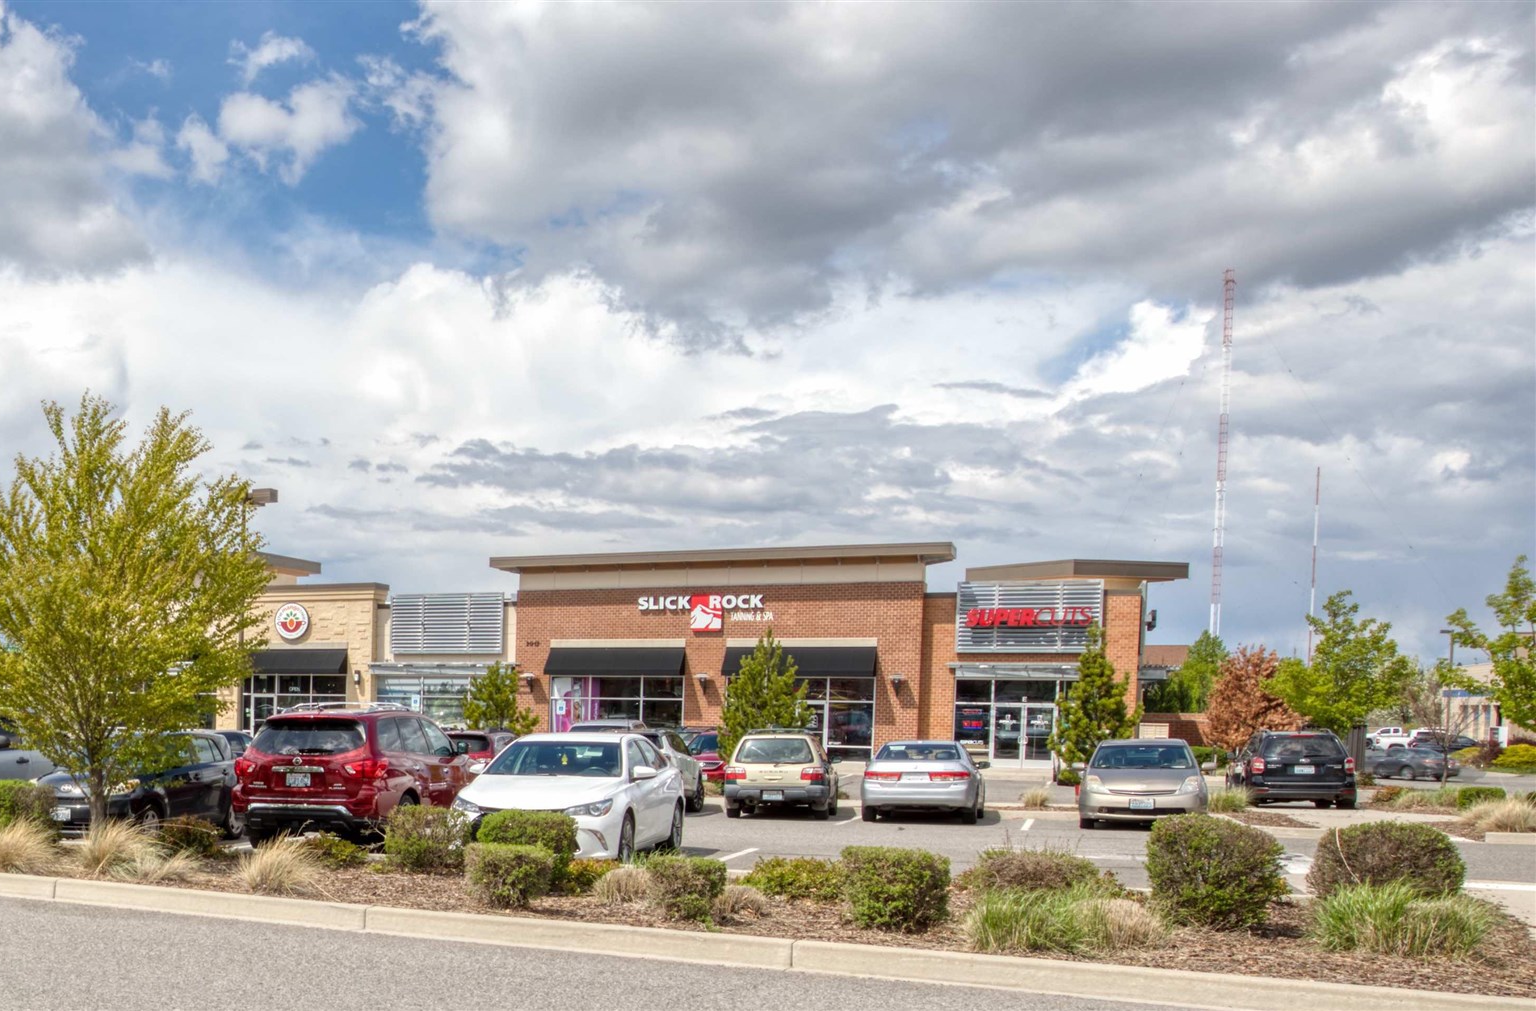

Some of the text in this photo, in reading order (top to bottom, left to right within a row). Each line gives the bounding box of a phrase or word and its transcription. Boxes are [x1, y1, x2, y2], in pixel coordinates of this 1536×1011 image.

[638, 595, 764, 610] SLICK ROCK
[730, 611, 774, 621] TANNING & SPA
[965, 607, 1093, 627] SUPERCUTS
